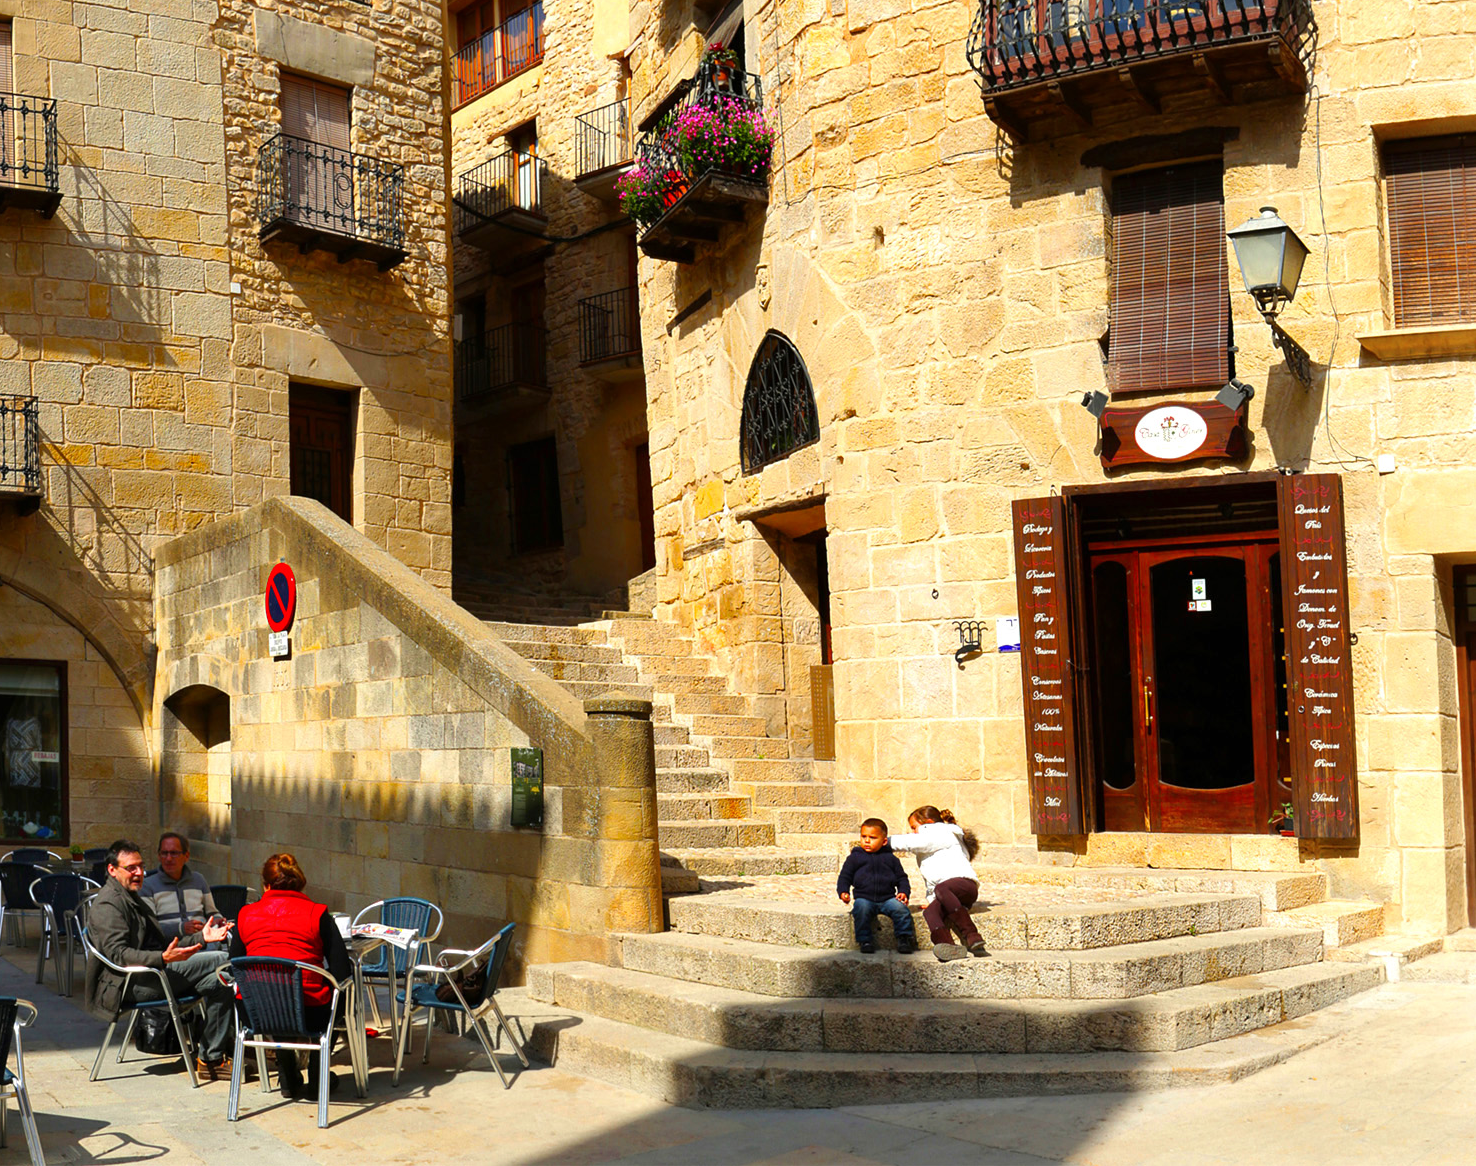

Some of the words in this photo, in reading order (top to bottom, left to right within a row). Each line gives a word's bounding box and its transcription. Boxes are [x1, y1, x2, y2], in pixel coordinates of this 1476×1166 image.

[1294, 503, 1319, 515] Quesos
[1319, 504, 1331, 514] del
[1047, 525, 1053, 535] y
[1296, 551, 1333, 562] Embutidos
[1025, 569, 1056, 580] Productos
[1312, 570, 1321, 579] y
[1294, 584, 1326, 596] Jamones
[1328, 604, 1337, 613] de
[1033, 612, 1049, 624] Pan
[1048, 617, 1055, 625] y
[1317, 618, 1340, 630] Teruel
[1034, 629, 1056, 640] Pastas
[1308, 640, 1316, 650] y
[1300, 655, 1309, 664] de
[1310, 653, 1340, 665] Calidad
[1031, 675, 1062, 686] Conservas
[1032, 690, 1063, 701] Artesanas
[1304, 687, 1339, 699] Cerámica
[1041, 707, 1060, 715] 100%
[1034, 722, 1063, 732] Naturales
[1313, 758, 1337, 768] Puras
[1044, 795, 1061, 807] Miel
[1310, 791, 1339, 803] Hierbas
